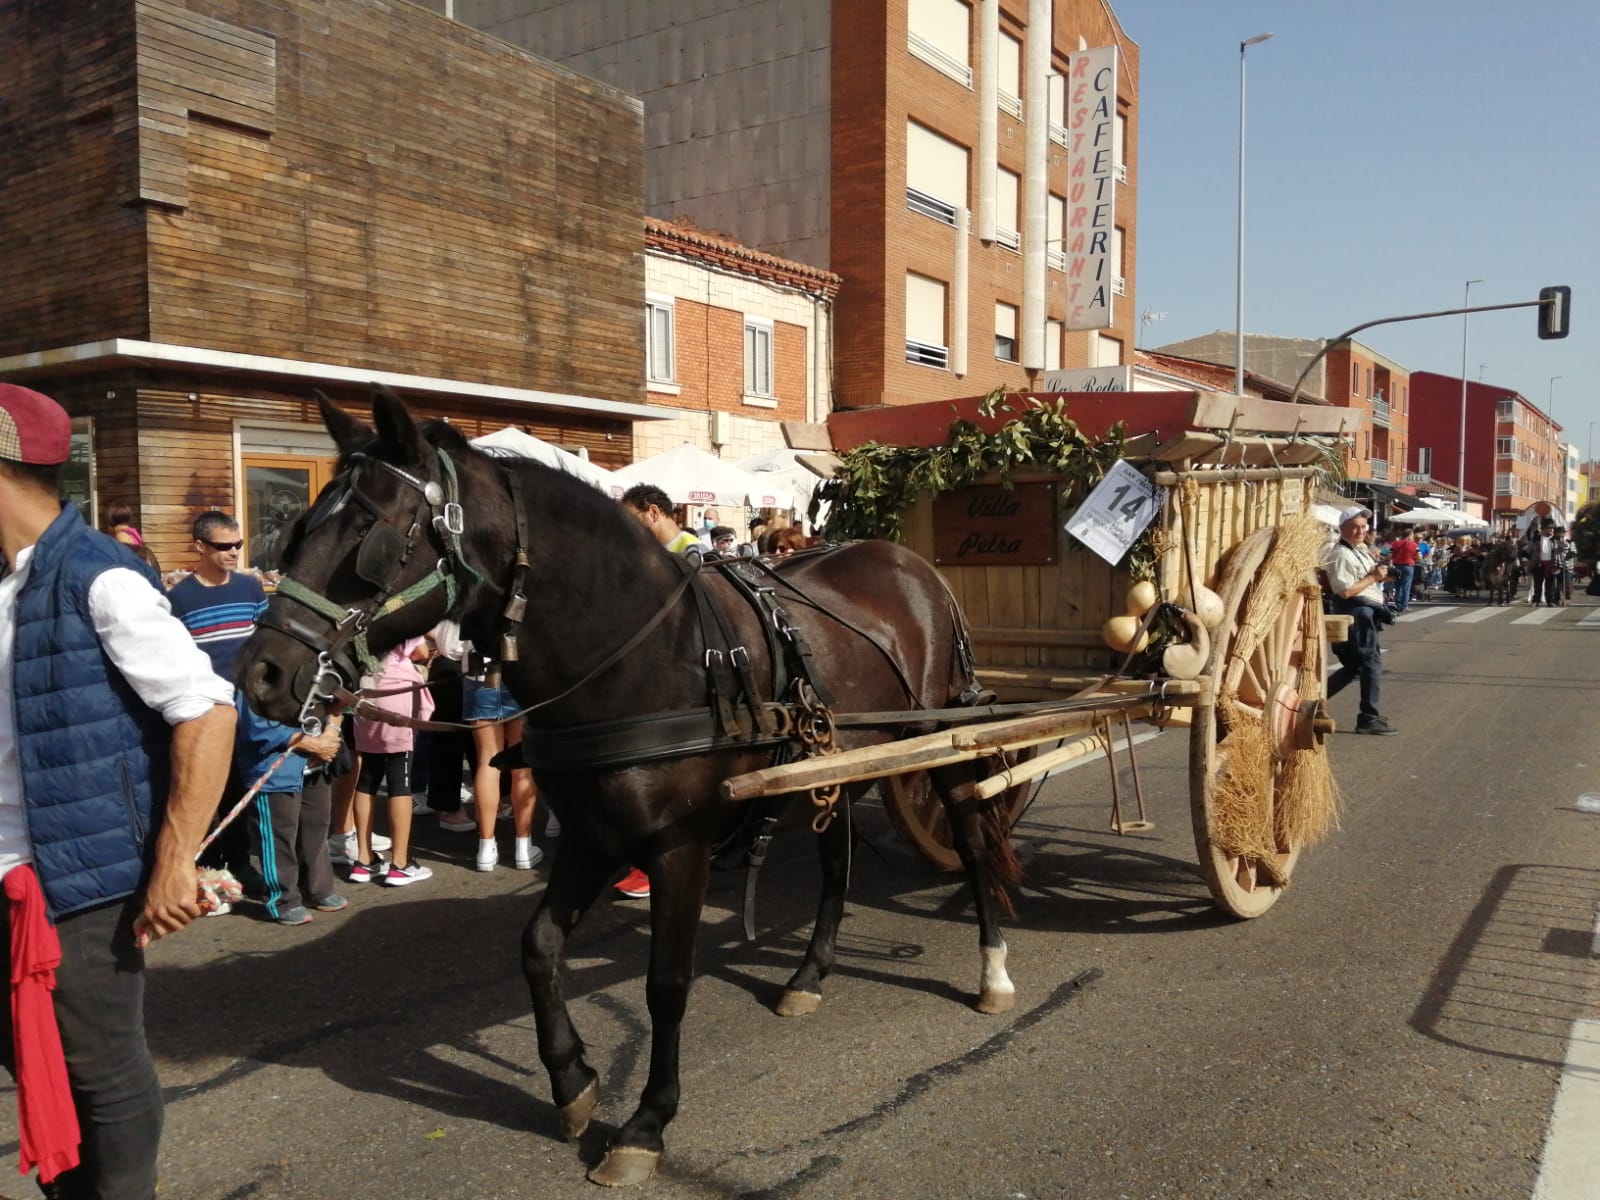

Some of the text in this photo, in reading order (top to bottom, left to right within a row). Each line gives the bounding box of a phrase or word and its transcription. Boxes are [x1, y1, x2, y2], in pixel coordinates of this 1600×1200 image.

[1069, 56, 1090, 326] RESTAURANTE
[1088, 66, 1113, 310] CAFETERIA
[966, 494, 1022, 518] Villa
[1107, 483, 1148, 523] 14
[956, 532, 1024, 558] Petra
